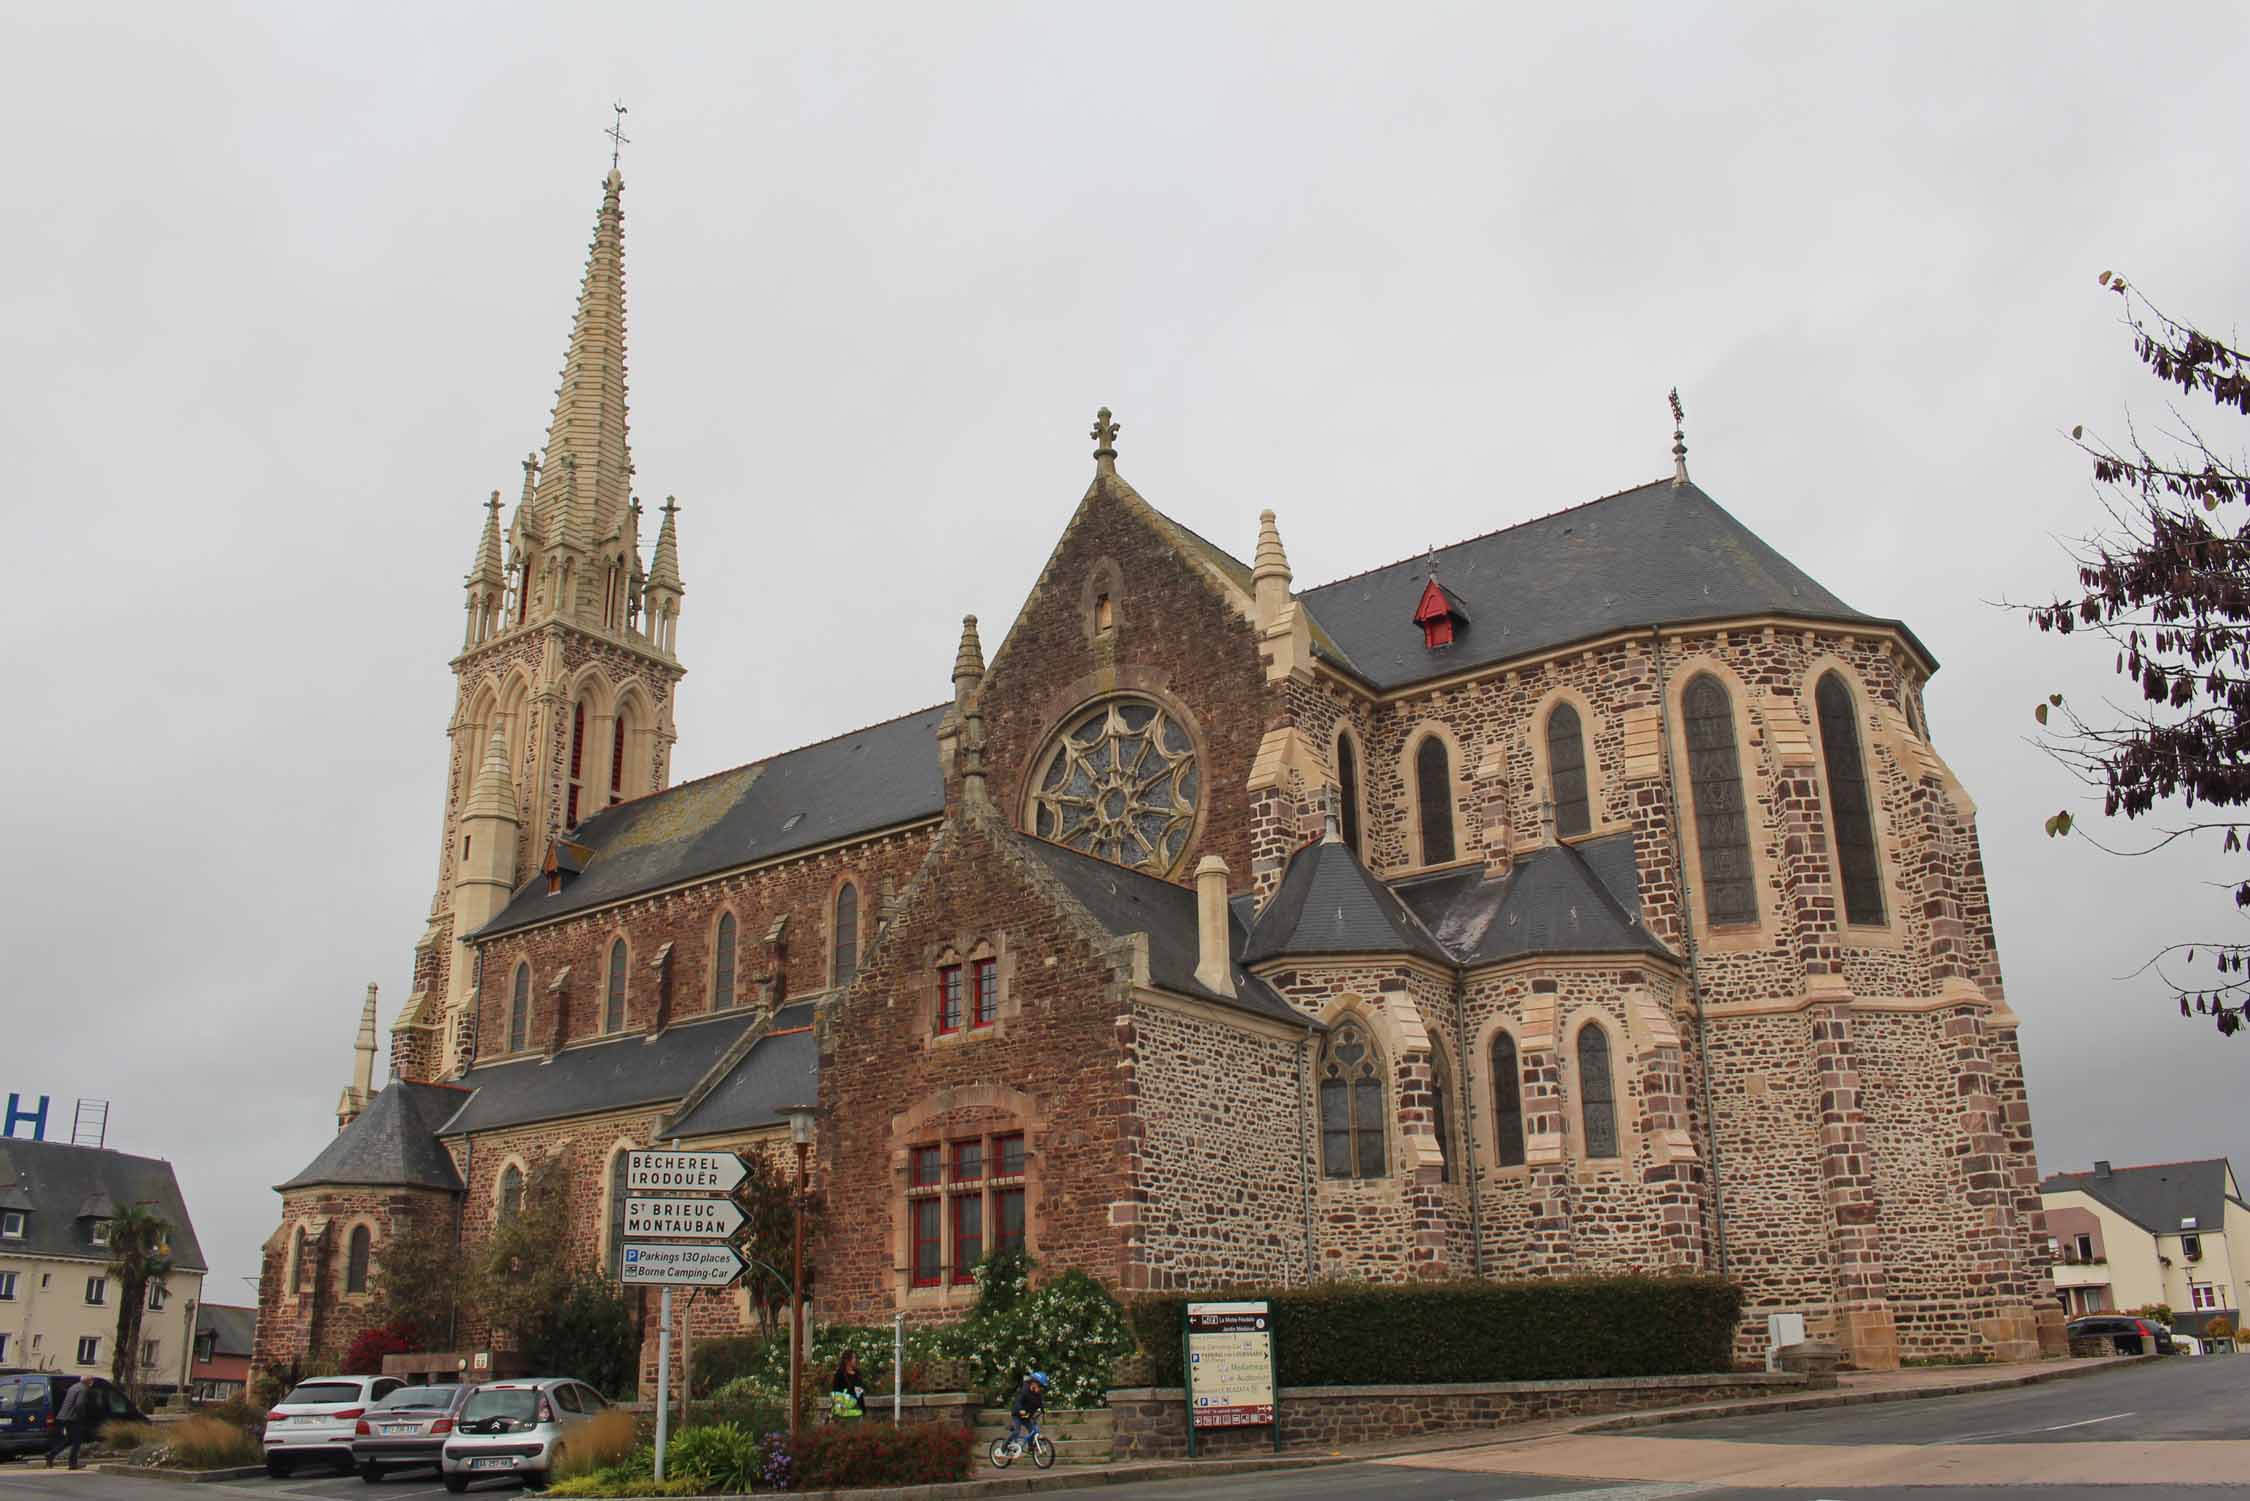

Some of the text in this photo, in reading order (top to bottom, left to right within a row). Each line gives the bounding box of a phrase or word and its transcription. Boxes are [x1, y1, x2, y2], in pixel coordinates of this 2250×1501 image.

[633, 1155, 719, 1170] BÉCHEREL
[632, 1171, 718, 1185] IRODOUËR
[653, 1204, 715, 1217] BRIEUC
[628, 1220, 726, 1233] MONTAUBAN
[639, 1251, 680, 1264] Parkings
[682, 1252, 700, 1262] 130
[700, 1253, 731, 1264] places
[638, 1266, 729, 1280] Borne Camping-Car
